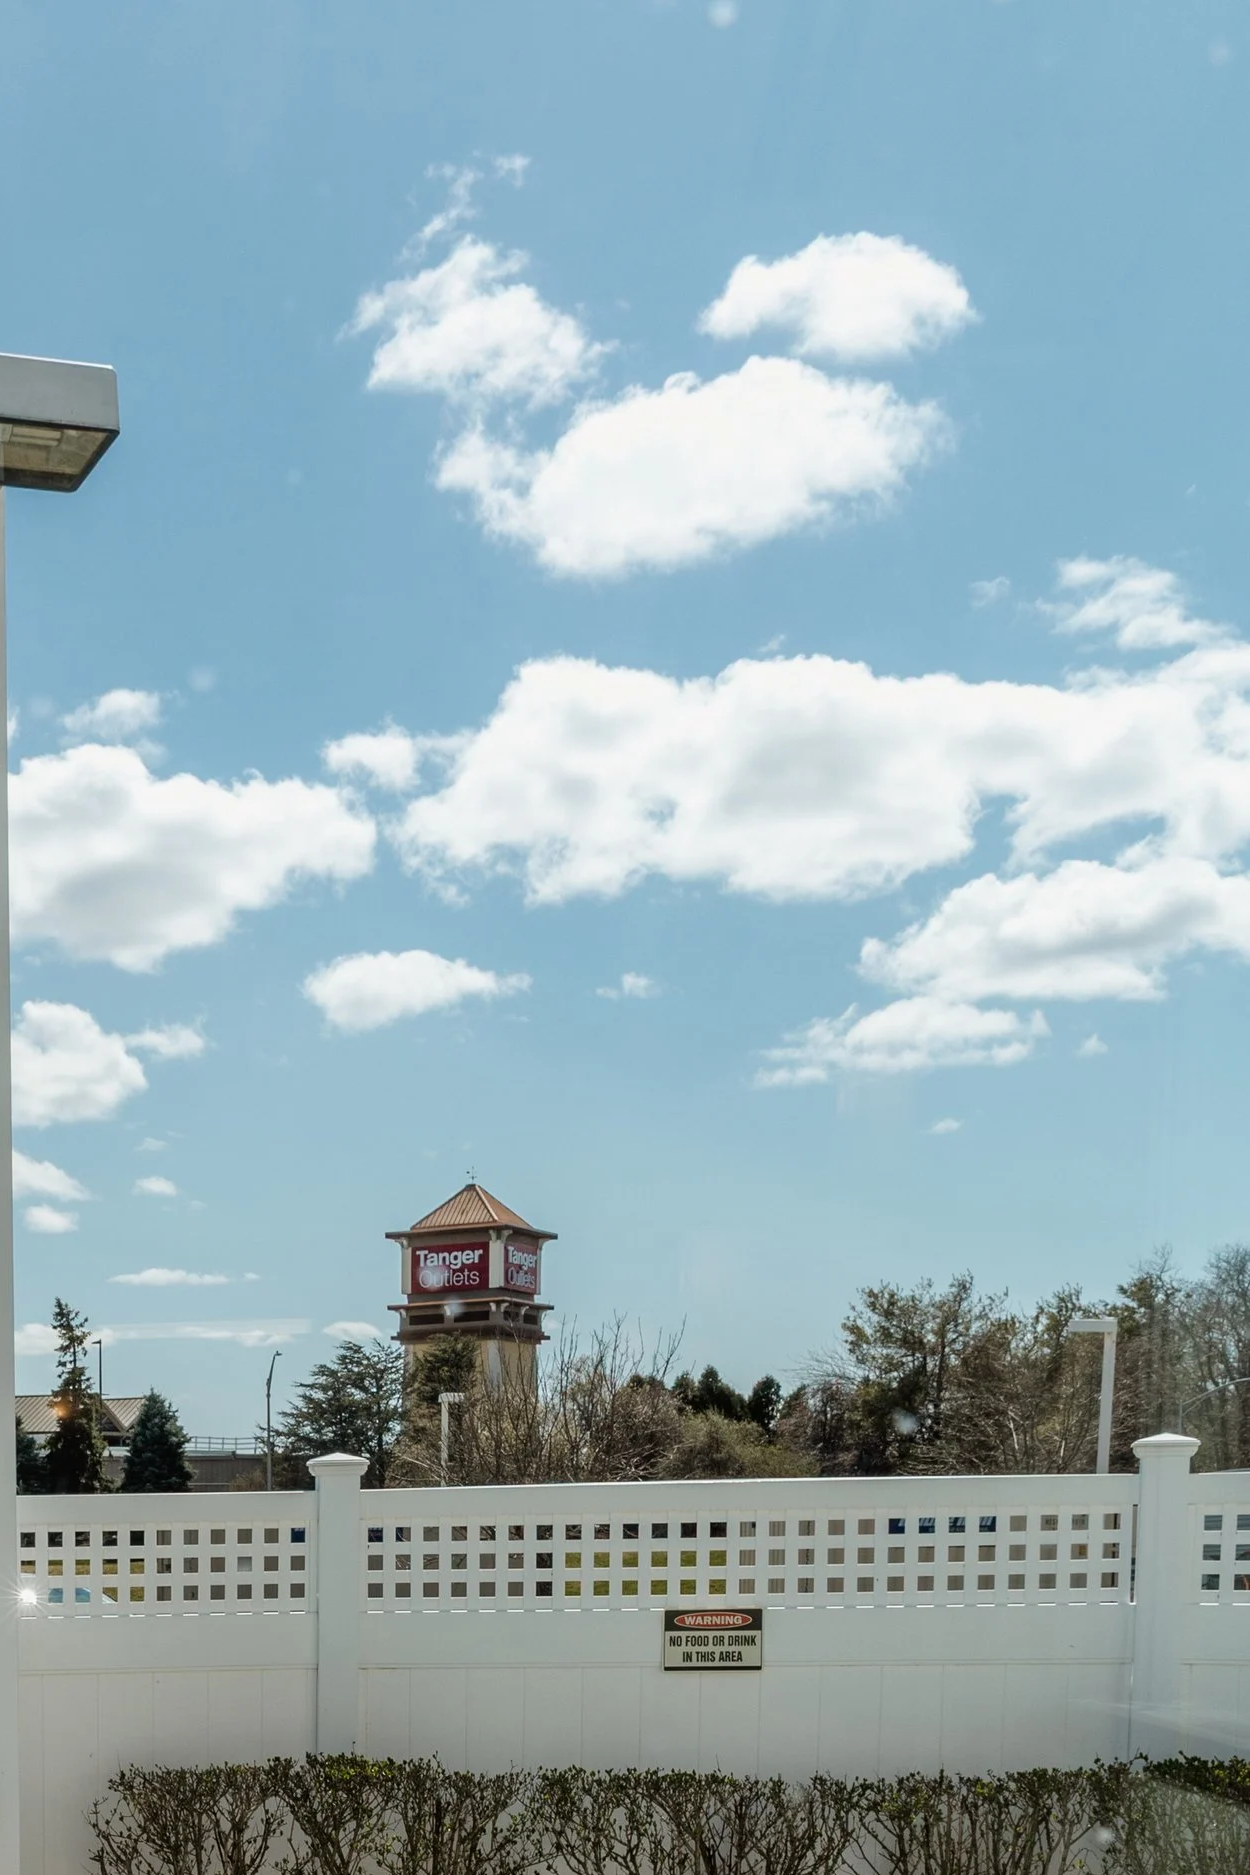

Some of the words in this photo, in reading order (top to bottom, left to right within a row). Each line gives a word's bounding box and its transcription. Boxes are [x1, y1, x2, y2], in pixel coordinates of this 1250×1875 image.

[416, 1249, 483, 1269] Tanger
[508, 1246, 537, 1270] Tanger
[419, 1268, 480, 1288] Outlets
[684, 1615, 742, 1625] WARNING
[669, 1635, 682, 1647] NO
[685, 1635, 709, 1647] FOOD
[712, 1635, 725, 1646] OR
[728, 1635, 757, 1646] DRINK
[683, 1651, 692, 1663] IN
[695, 1651, 716, 1662] THIS
[718, 1651, 743, 1662] AREA
